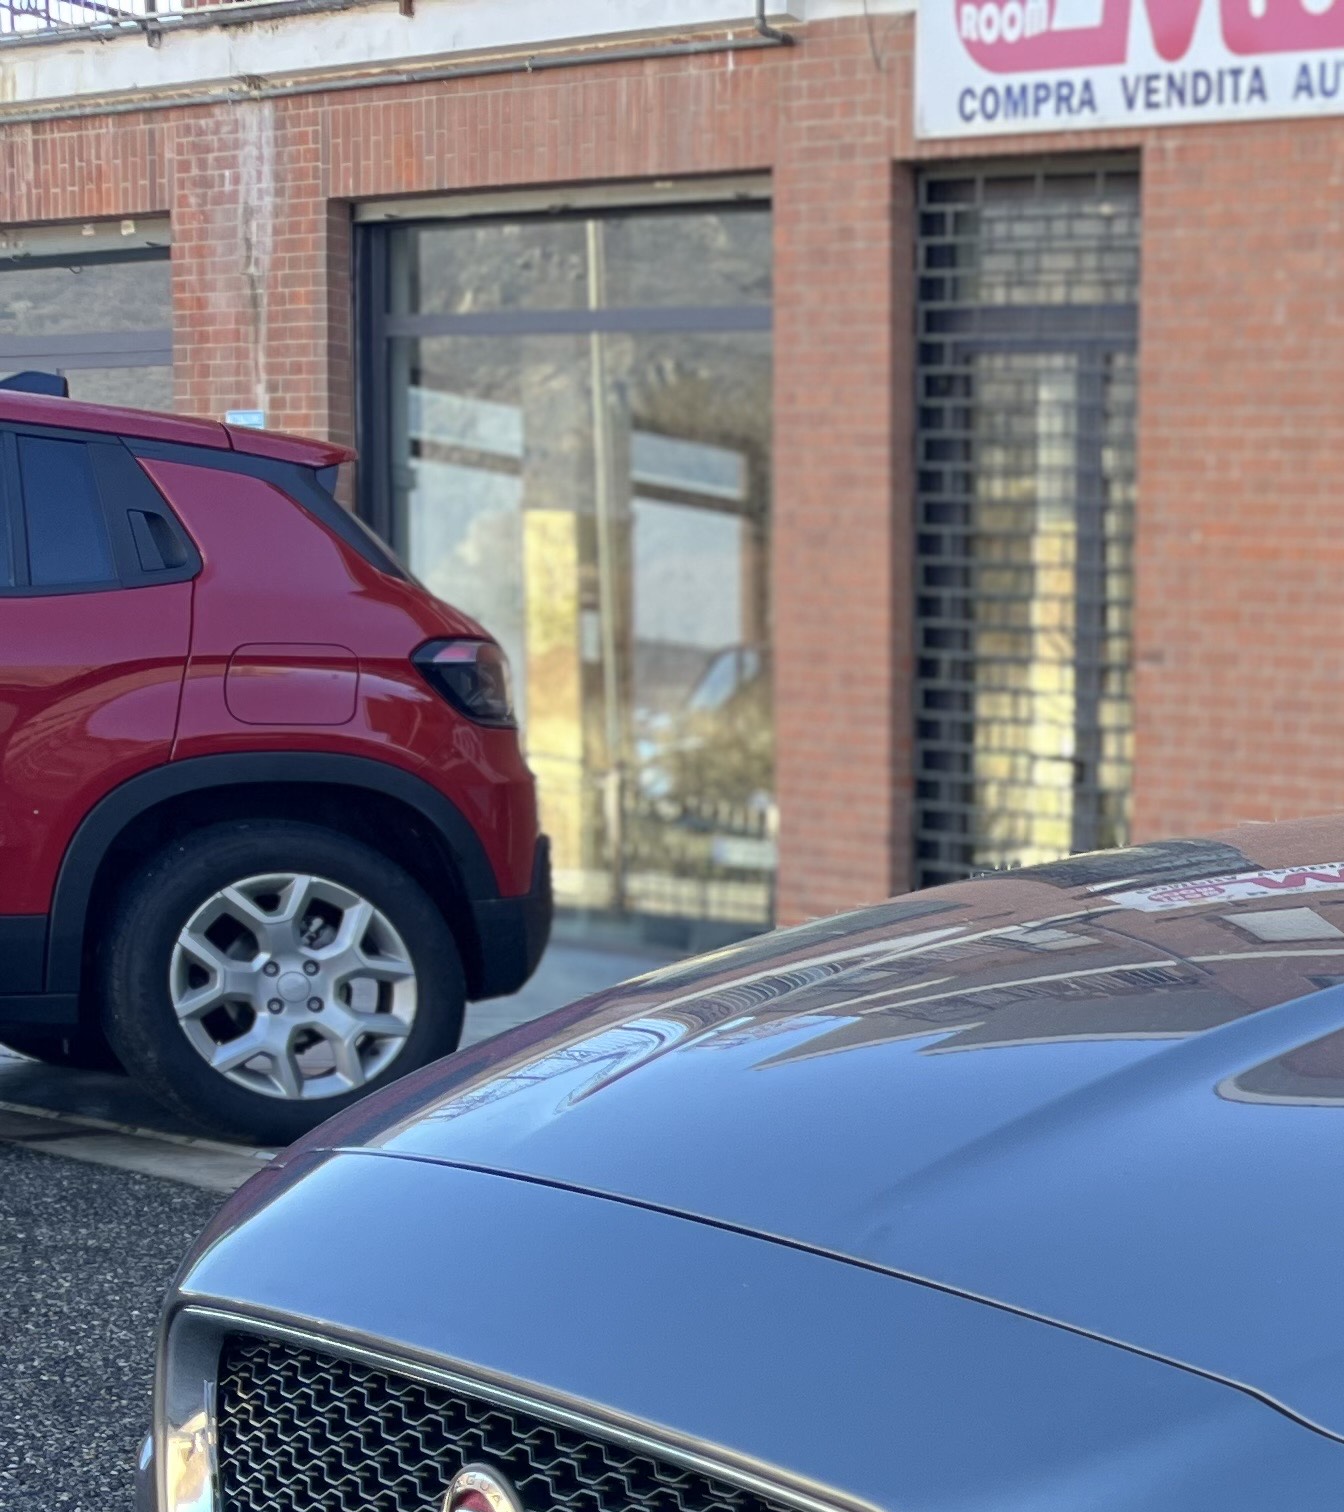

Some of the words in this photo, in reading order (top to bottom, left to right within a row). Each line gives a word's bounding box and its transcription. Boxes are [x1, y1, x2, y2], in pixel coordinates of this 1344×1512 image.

[960, 1, 1048, 43] ROOM
[958, 79, 1098, 122] COMPRA
[1121, 66, 1267, 111] VENDITA
